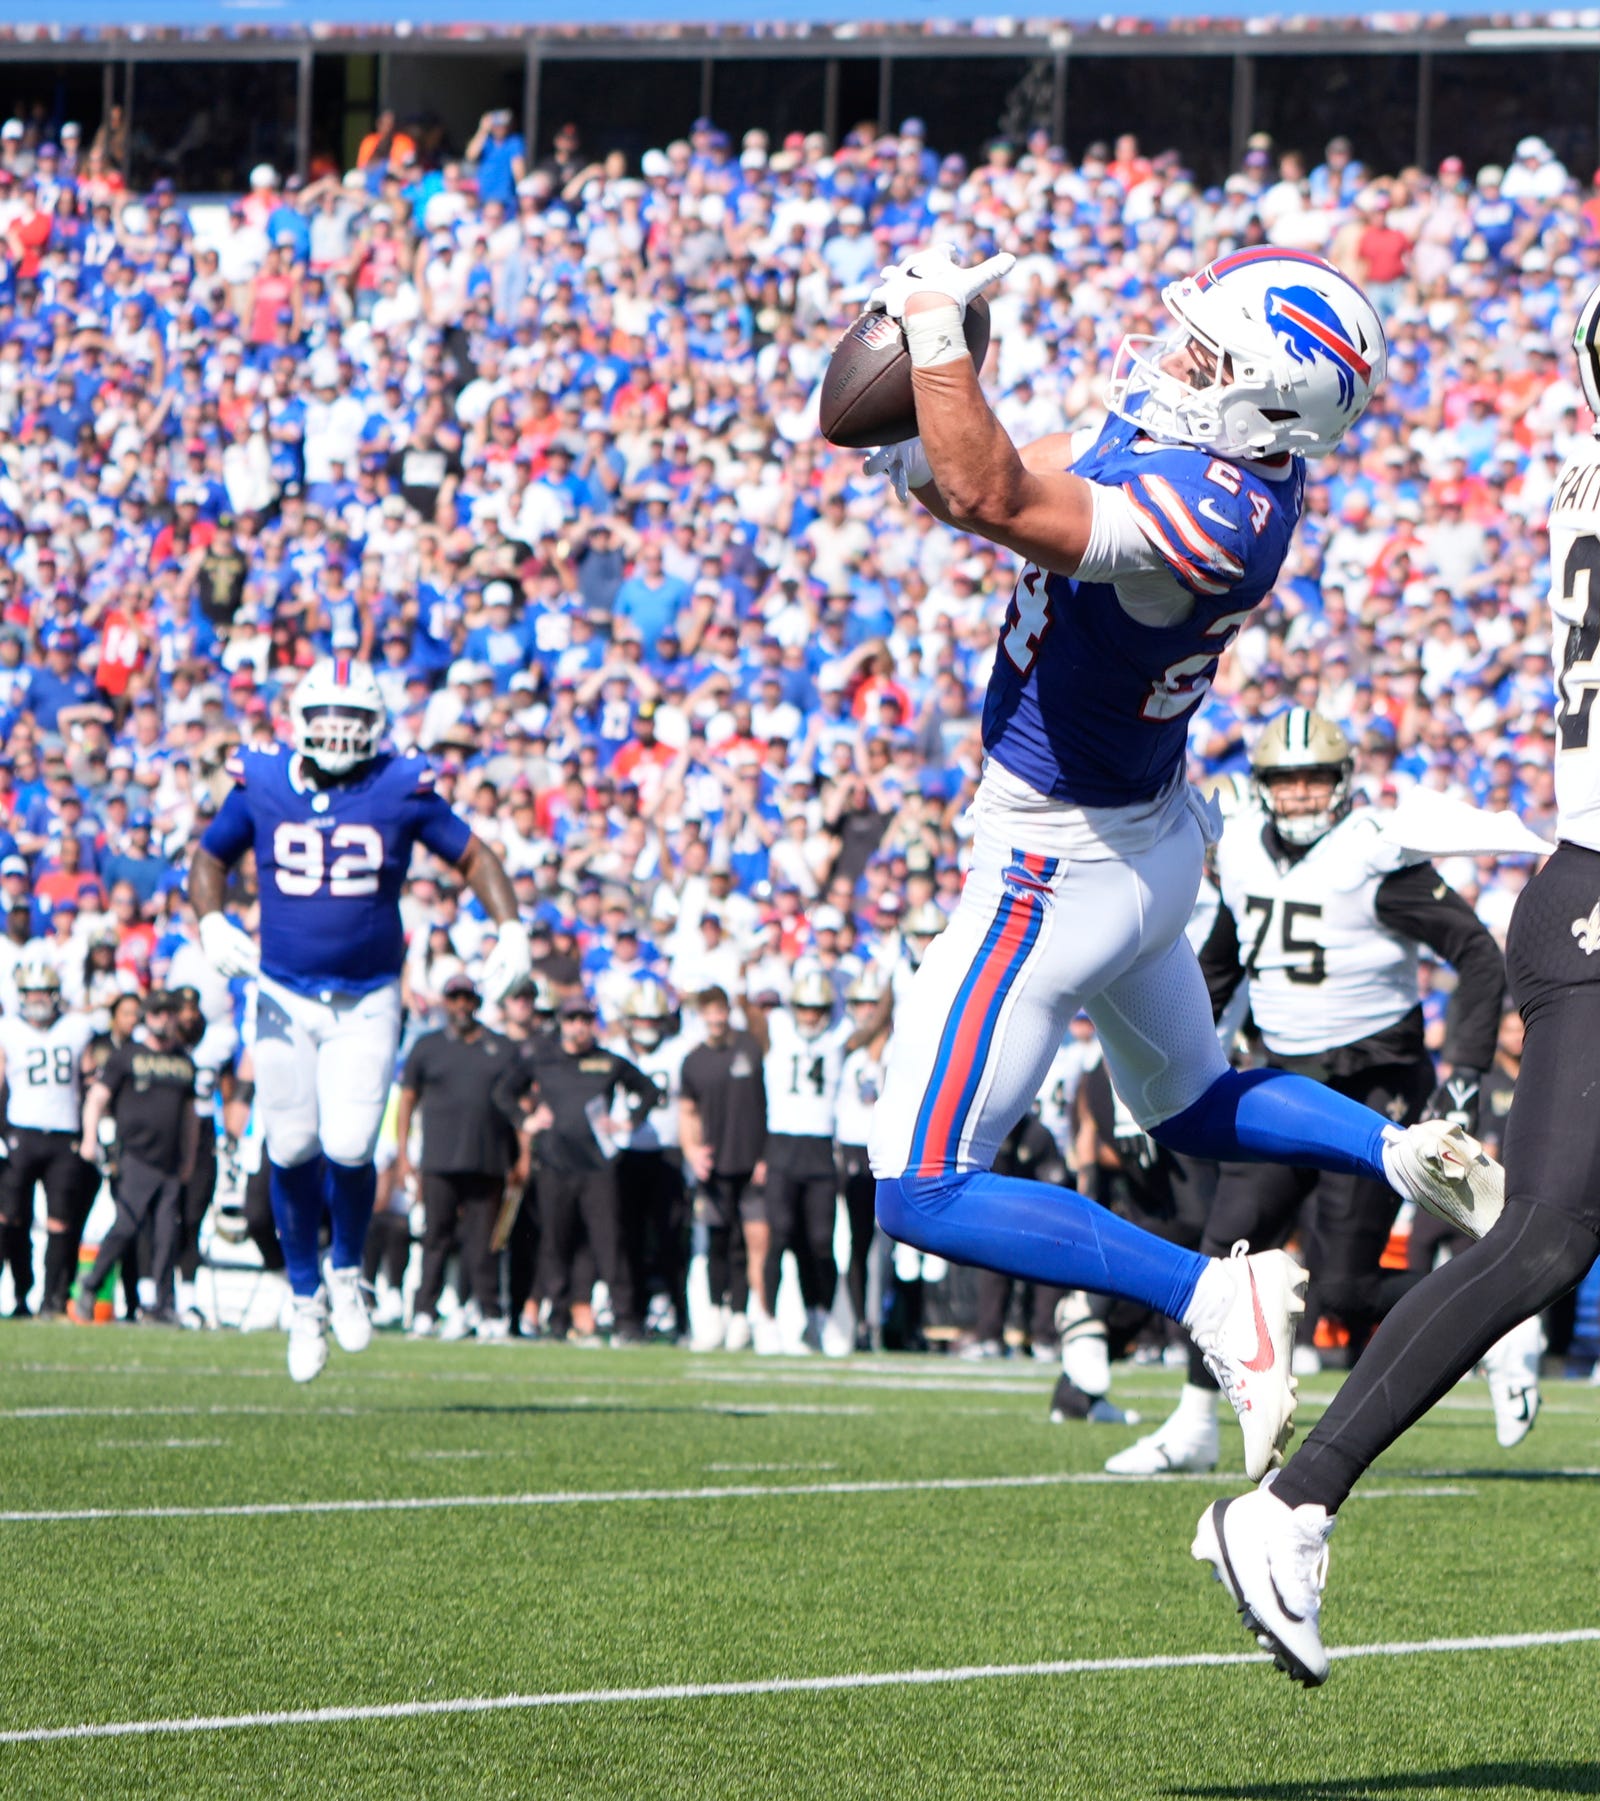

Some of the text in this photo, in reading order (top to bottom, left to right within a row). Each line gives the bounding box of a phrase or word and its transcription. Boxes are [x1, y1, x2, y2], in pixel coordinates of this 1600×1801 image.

[866, 318, 897, 345] NFL
[1203, 457, 1274, 538] 24
[273, 821, 384, 897] 92
[1244, 893, 1327, 986] 75
[26, 1046, 74, 1086] 28
[789, 1053, 827, 1097] 14
